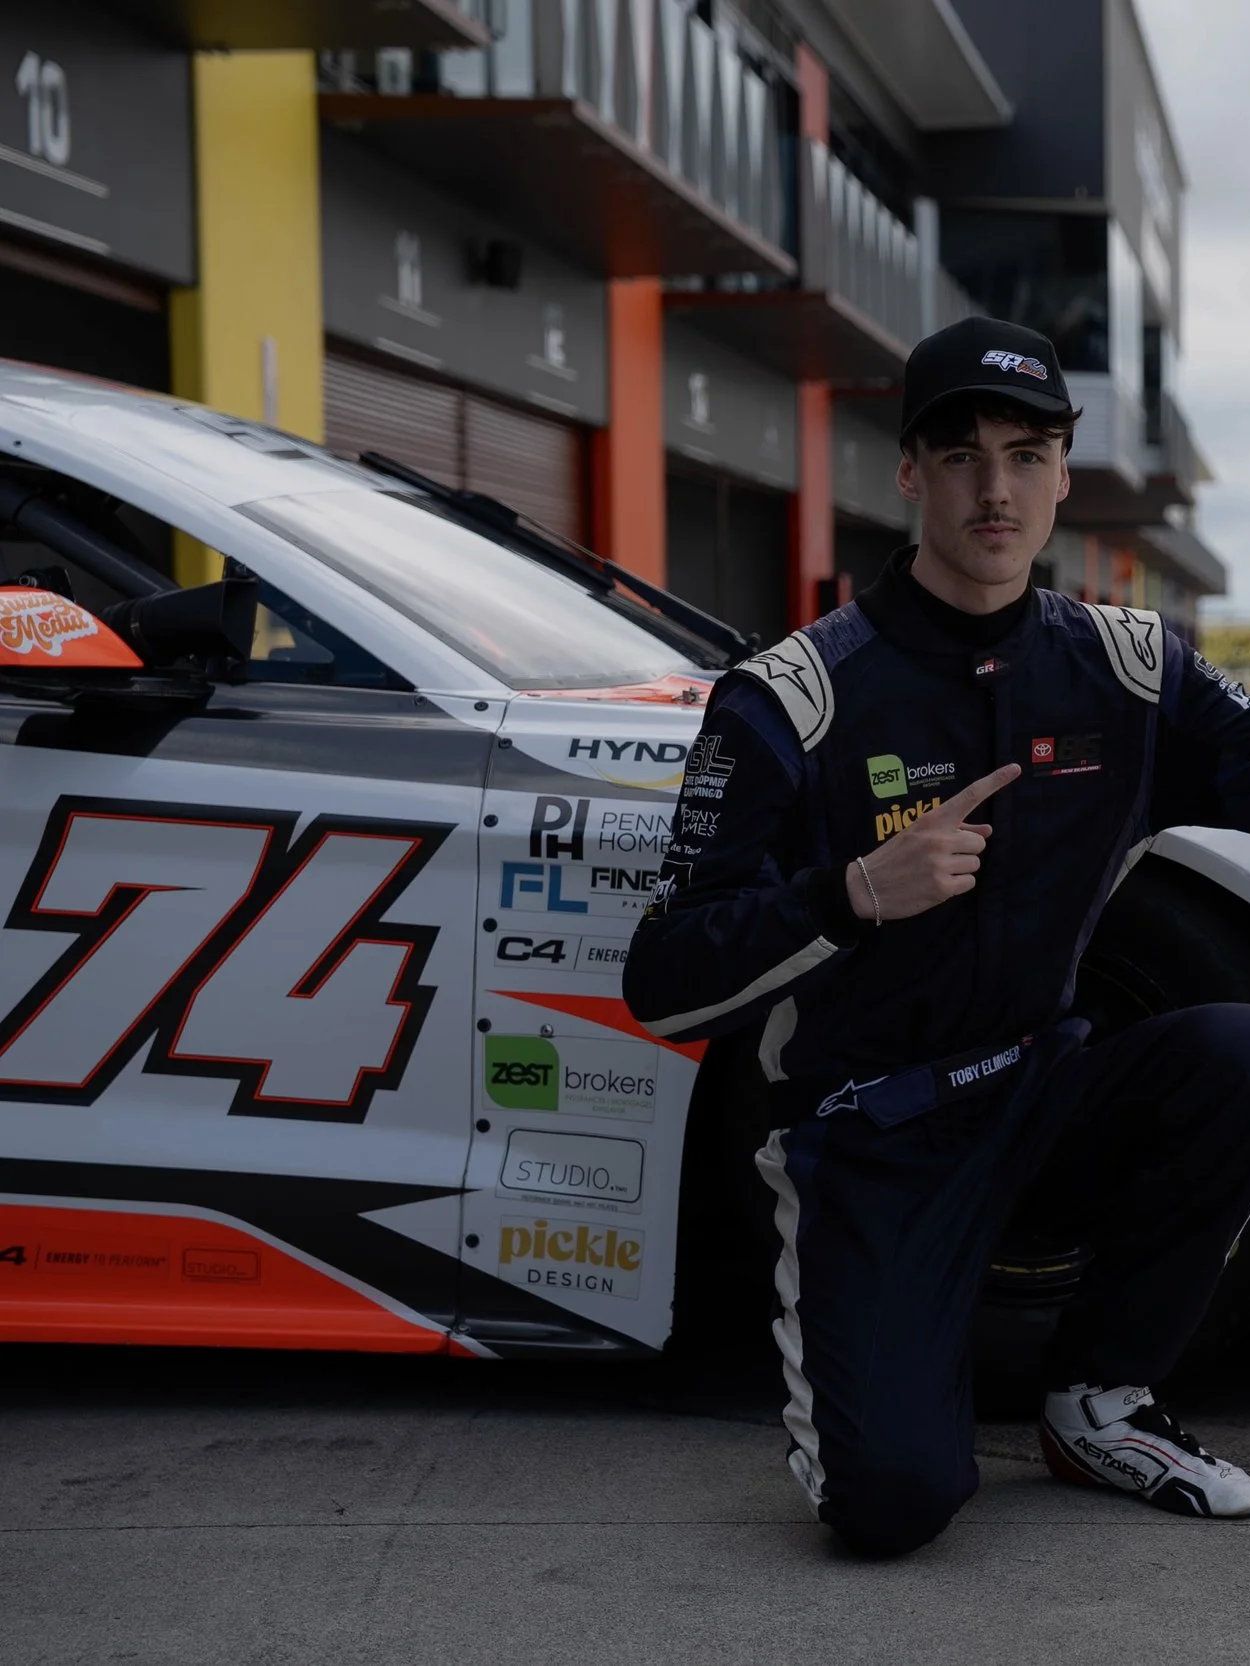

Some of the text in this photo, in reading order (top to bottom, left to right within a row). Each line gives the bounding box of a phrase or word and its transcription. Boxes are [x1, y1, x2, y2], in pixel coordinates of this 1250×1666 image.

[15, 49, 70, 166] 10
[976, 664, 995, 675] GR
[568, 738, 688, 763] HYND
[907, 762, 955, 779] brokers
[601, 812, 674, 833] PENN
[599, 831, 672, 853] HOME
[500, 861, 588, 913] FL
[622, 901, 645, 909] PAI
[0, 794, 459, 1123] 74
[497, 936, 628, 963] C4 ENERG
[564, 1066, 655, 1096] brokers
[949, 1065, 982, 1088] TOBY
[499, 1219, 641, 1271] pickle
[46, 1251, 90, 1264] ENERGY
[527, 1269, 614, 1292] DESIGN
